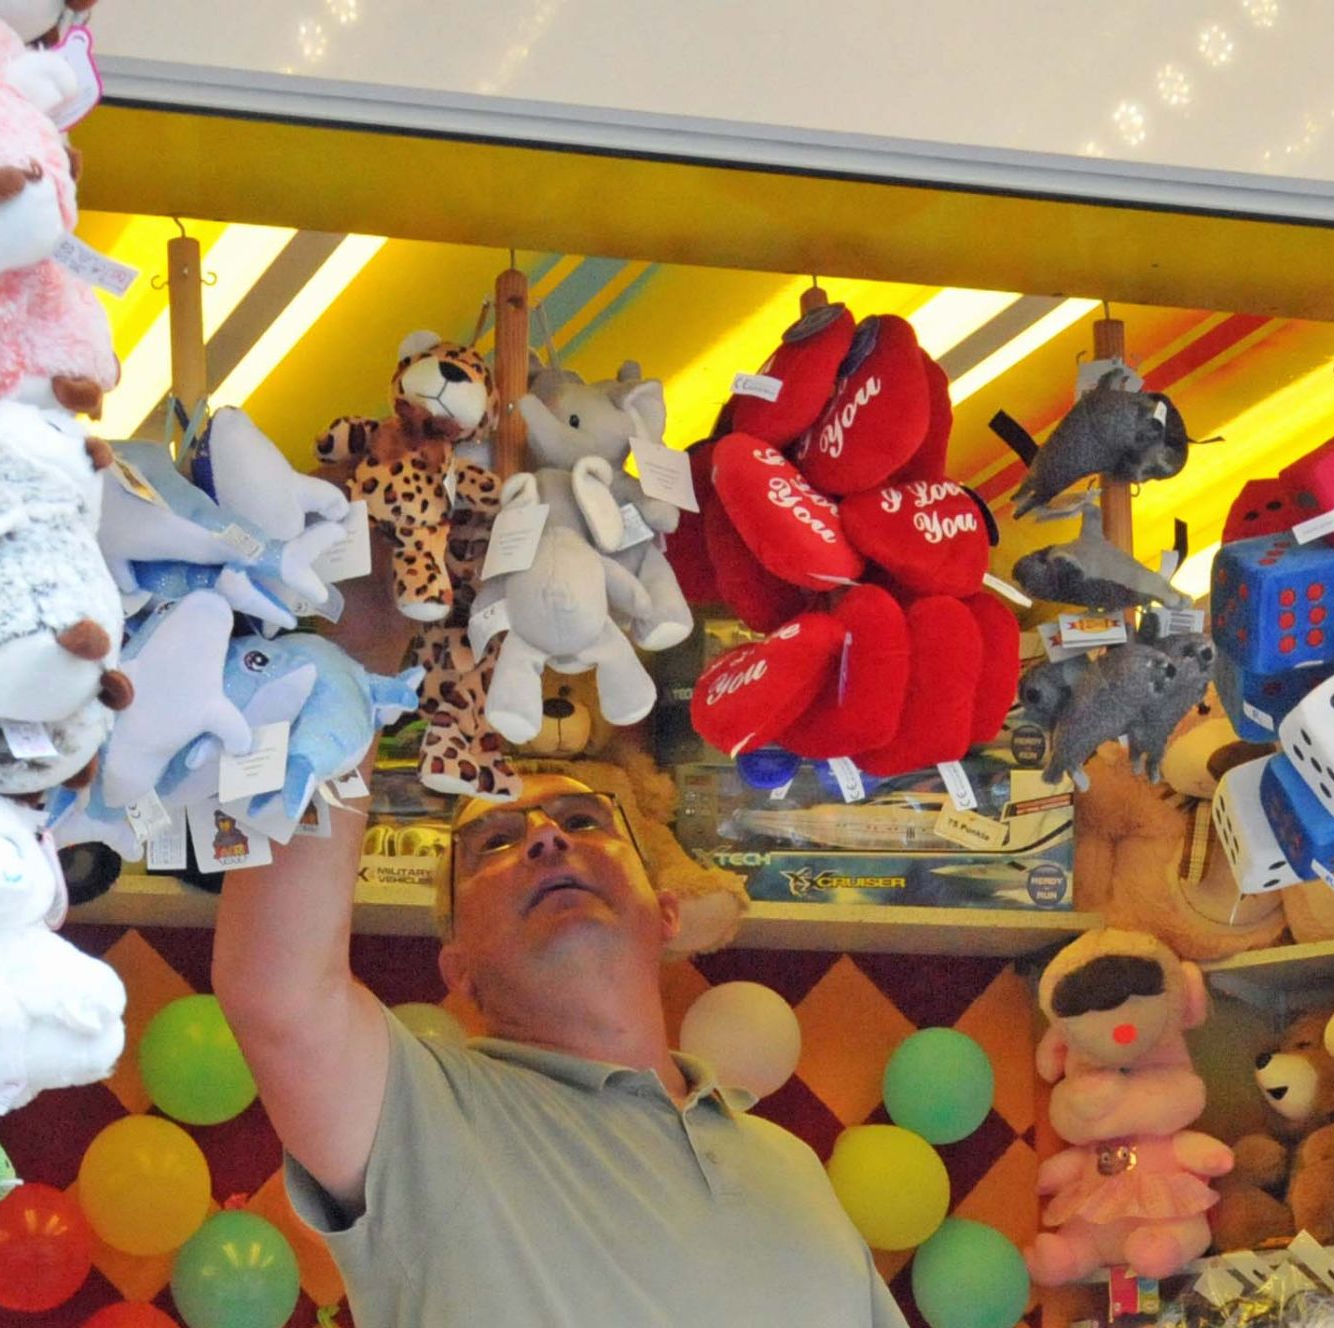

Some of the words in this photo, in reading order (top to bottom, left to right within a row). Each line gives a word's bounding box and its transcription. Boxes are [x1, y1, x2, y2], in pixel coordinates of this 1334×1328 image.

[820, 376, 881, 458] You
[768, 477, 838, 544] You
[913, 511, 978, 544] You
[961, 823, 990, 842] Punkte
